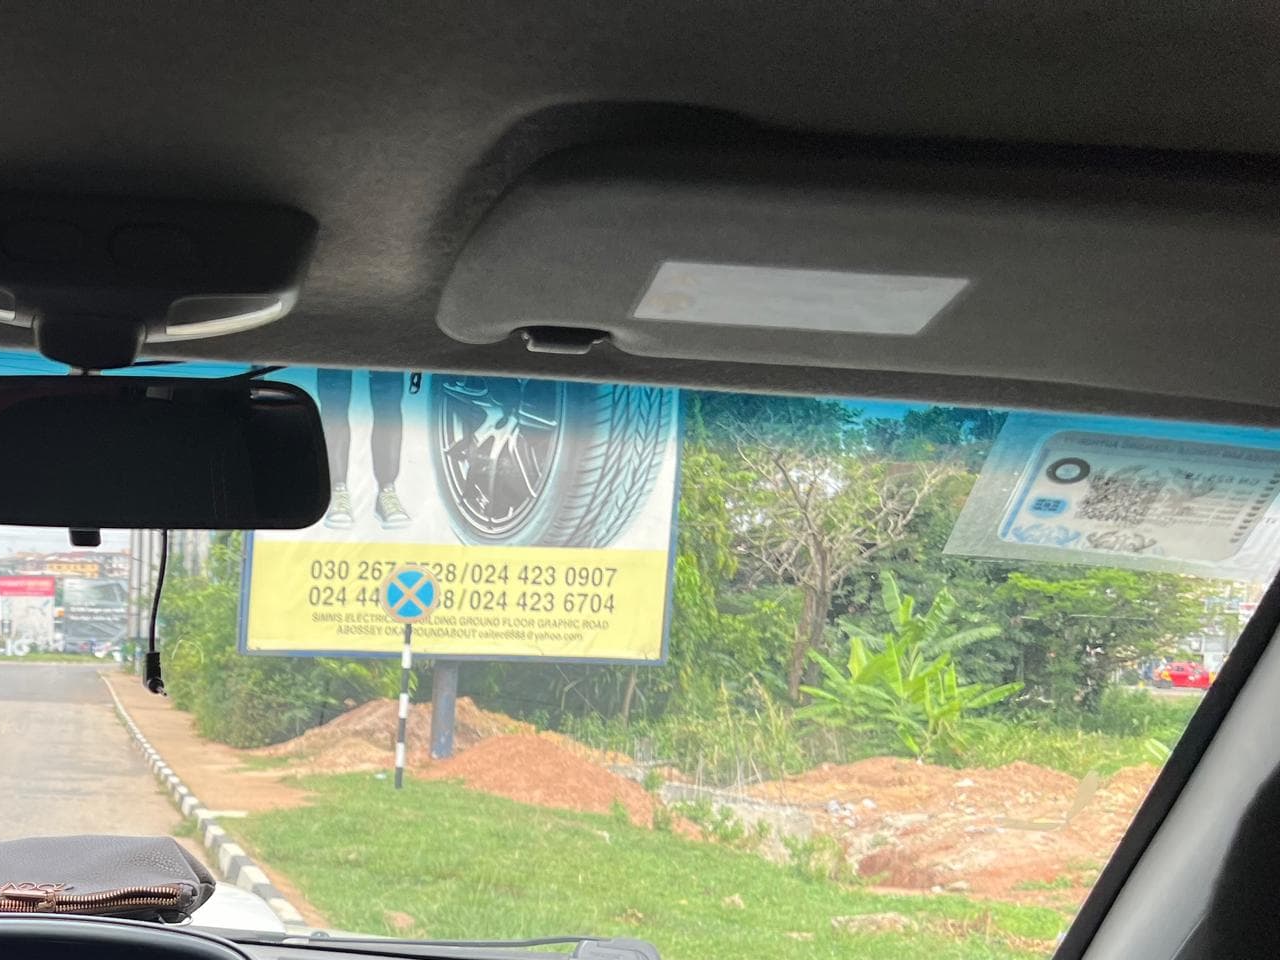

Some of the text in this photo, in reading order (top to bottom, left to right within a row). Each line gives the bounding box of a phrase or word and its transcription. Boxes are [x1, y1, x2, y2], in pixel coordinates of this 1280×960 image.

[311, 560, 350, 580] 030
[405, 562, 509, 585] 28/024
[518, 565, 556, 586] 423
[565, 566, 618, 588] 0907
[308, 586, 347, 606] 024
[516, 591, 555, 612] 423
[563, 593, 616, 614] 6704
[459, 616, 500, 627] GROUND
[502, 618, 535, 629] FLOOR
[537, 618, 580, 629] GRAPHIC
[582, 619, 609, 630] ROAD
